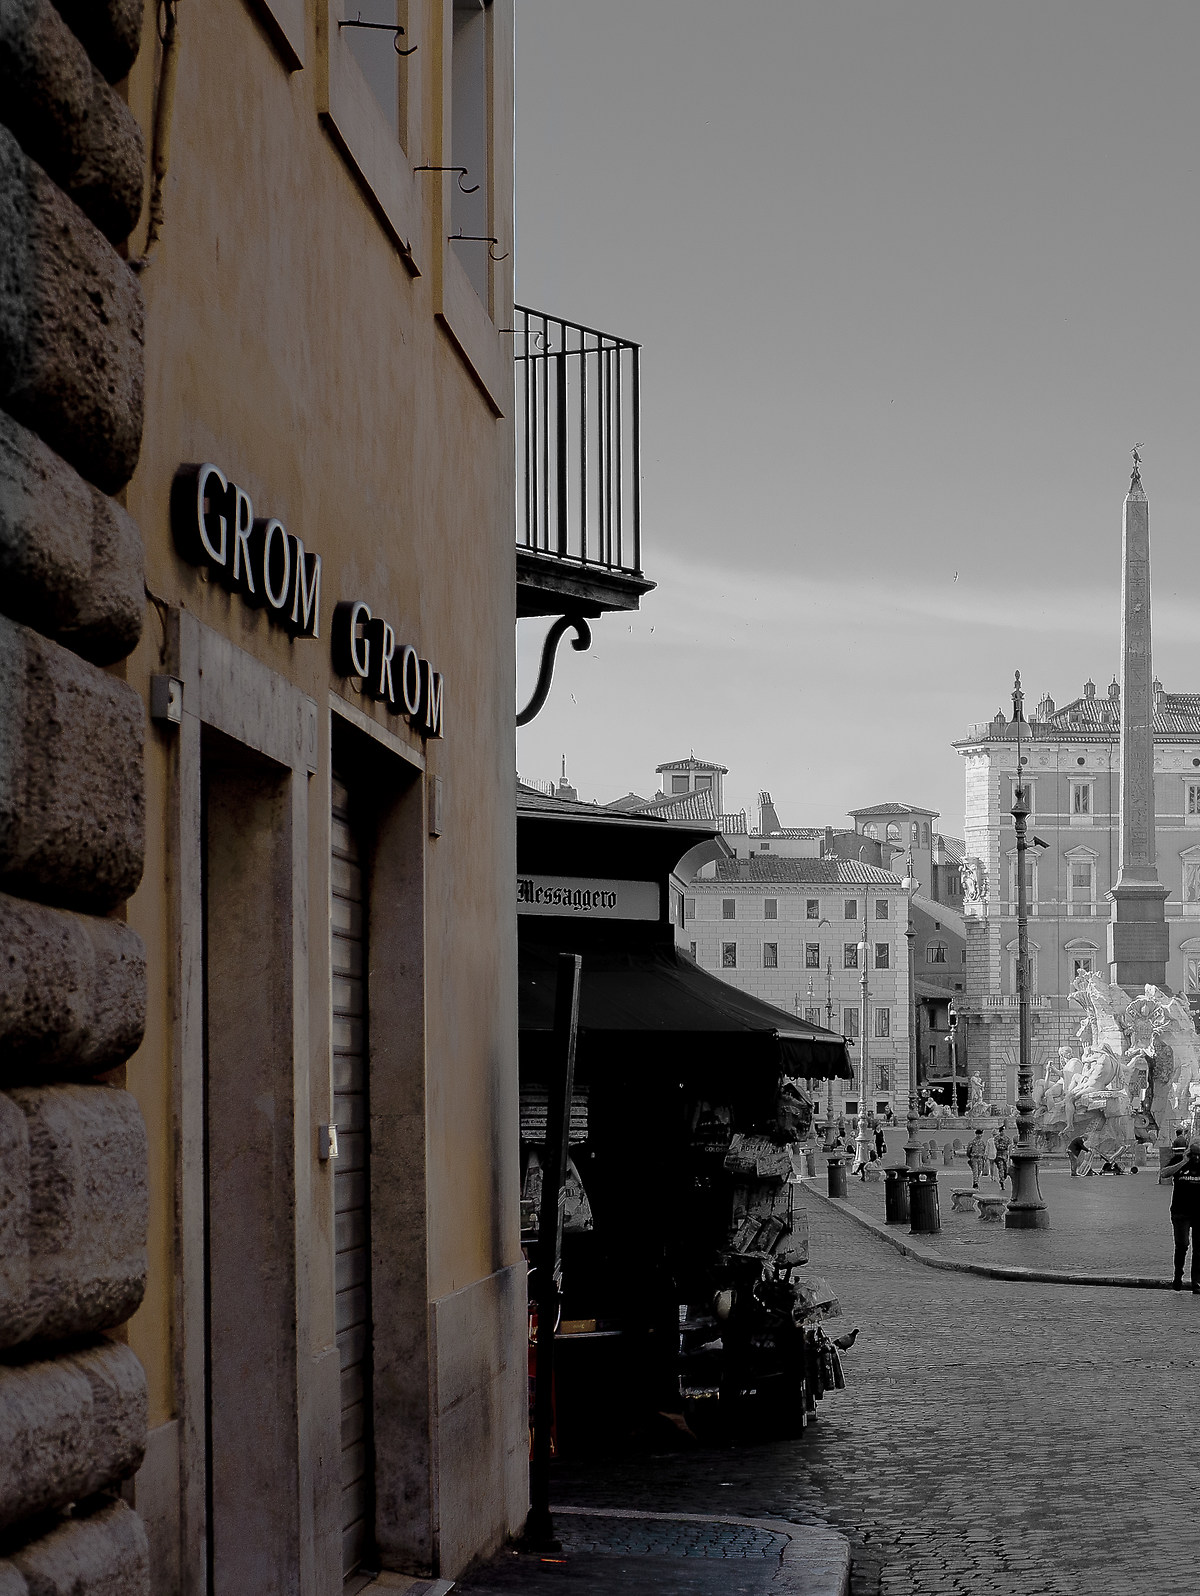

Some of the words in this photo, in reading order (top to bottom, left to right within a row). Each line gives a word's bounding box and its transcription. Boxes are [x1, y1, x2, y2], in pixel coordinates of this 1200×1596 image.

[197, 462, 322, 639] GROM
[350, 601, 444, 739] GROM
[517, 879, 617, 911] Messaggero
